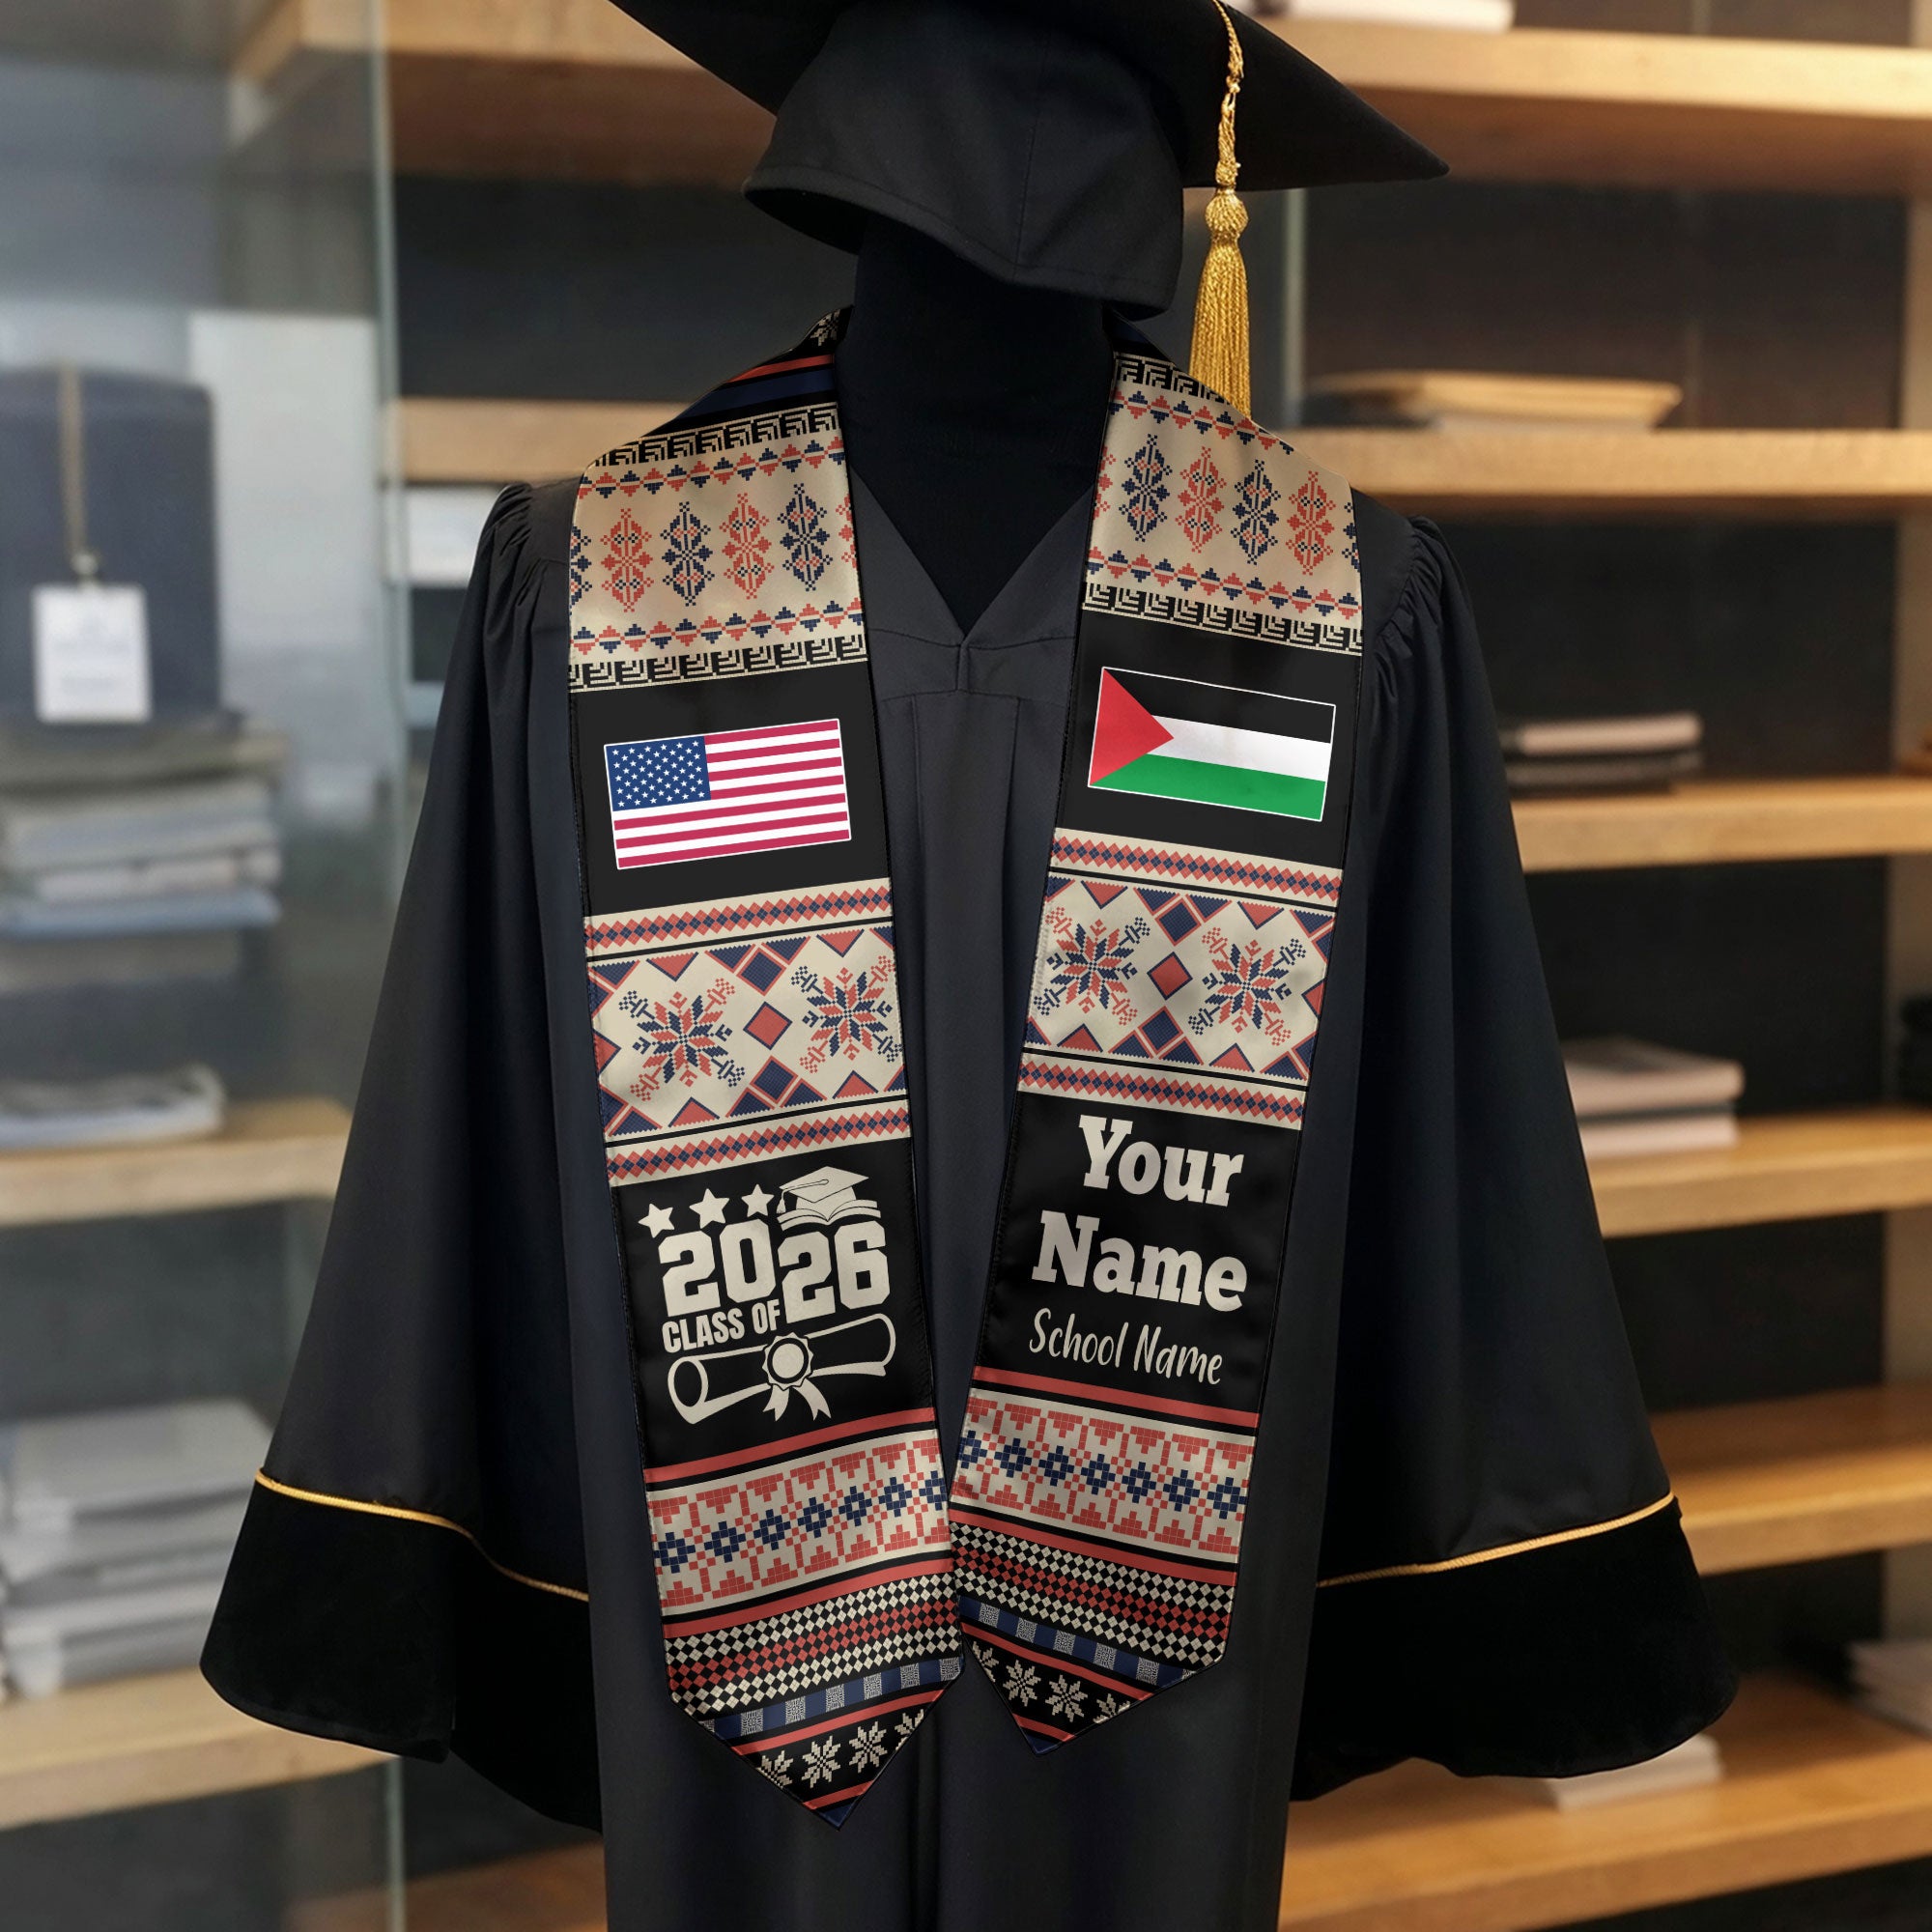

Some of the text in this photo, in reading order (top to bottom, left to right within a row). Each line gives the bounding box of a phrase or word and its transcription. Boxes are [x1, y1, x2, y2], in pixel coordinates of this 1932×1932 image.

[1078, 1114, 1244, 1207] Your
[658, 1218, 891, 1324] 2026
[1031, 1209, 1247, 1312] Name
[662, 1299, 780, 1353] CLASS OF
[1029, 1307, 1223, 1385] School Name
